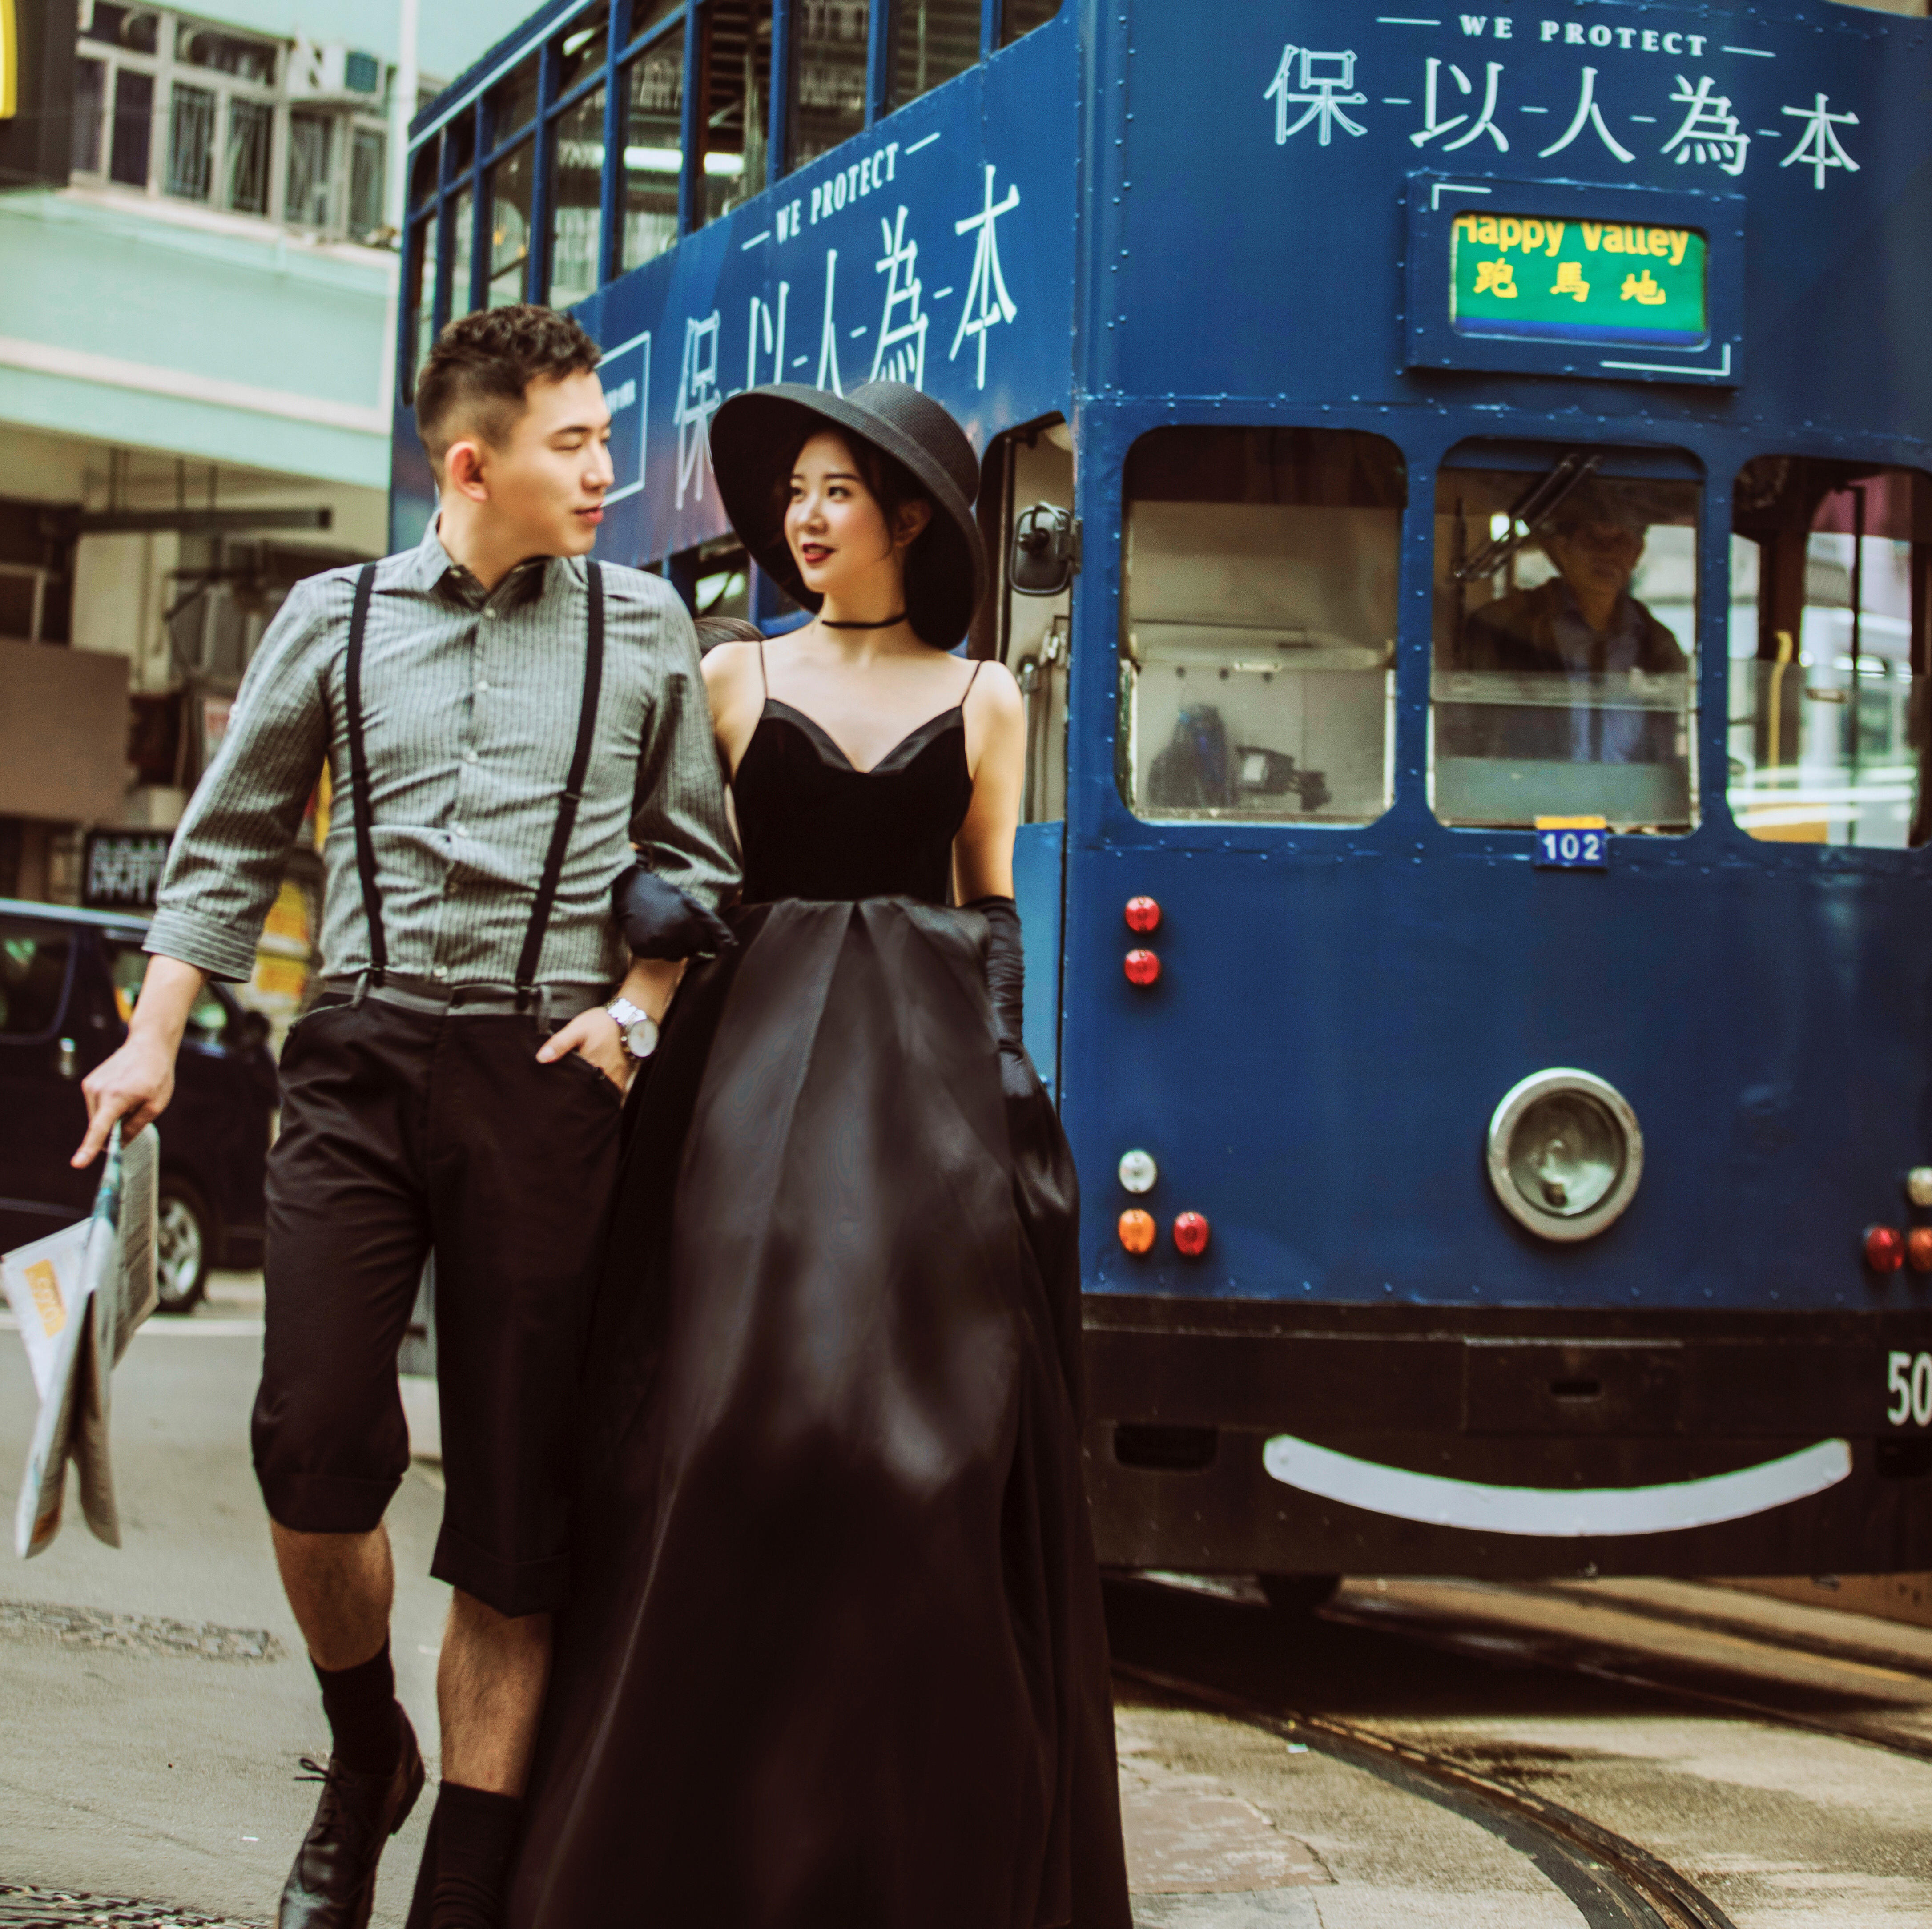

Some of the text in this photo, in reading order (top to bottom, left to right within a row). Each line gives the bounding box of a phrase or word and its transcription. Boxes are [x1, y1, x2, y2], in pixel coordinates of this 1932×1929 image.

[1460, 15, 1707, 56] WE PROTECT
[776, 142, 899, 243] WE PROTECT
[1581, 221, 1689, 266] Valley
[1542, 833, 1600, 860] 102
[1887, 1350, 1932, 1426] 50
